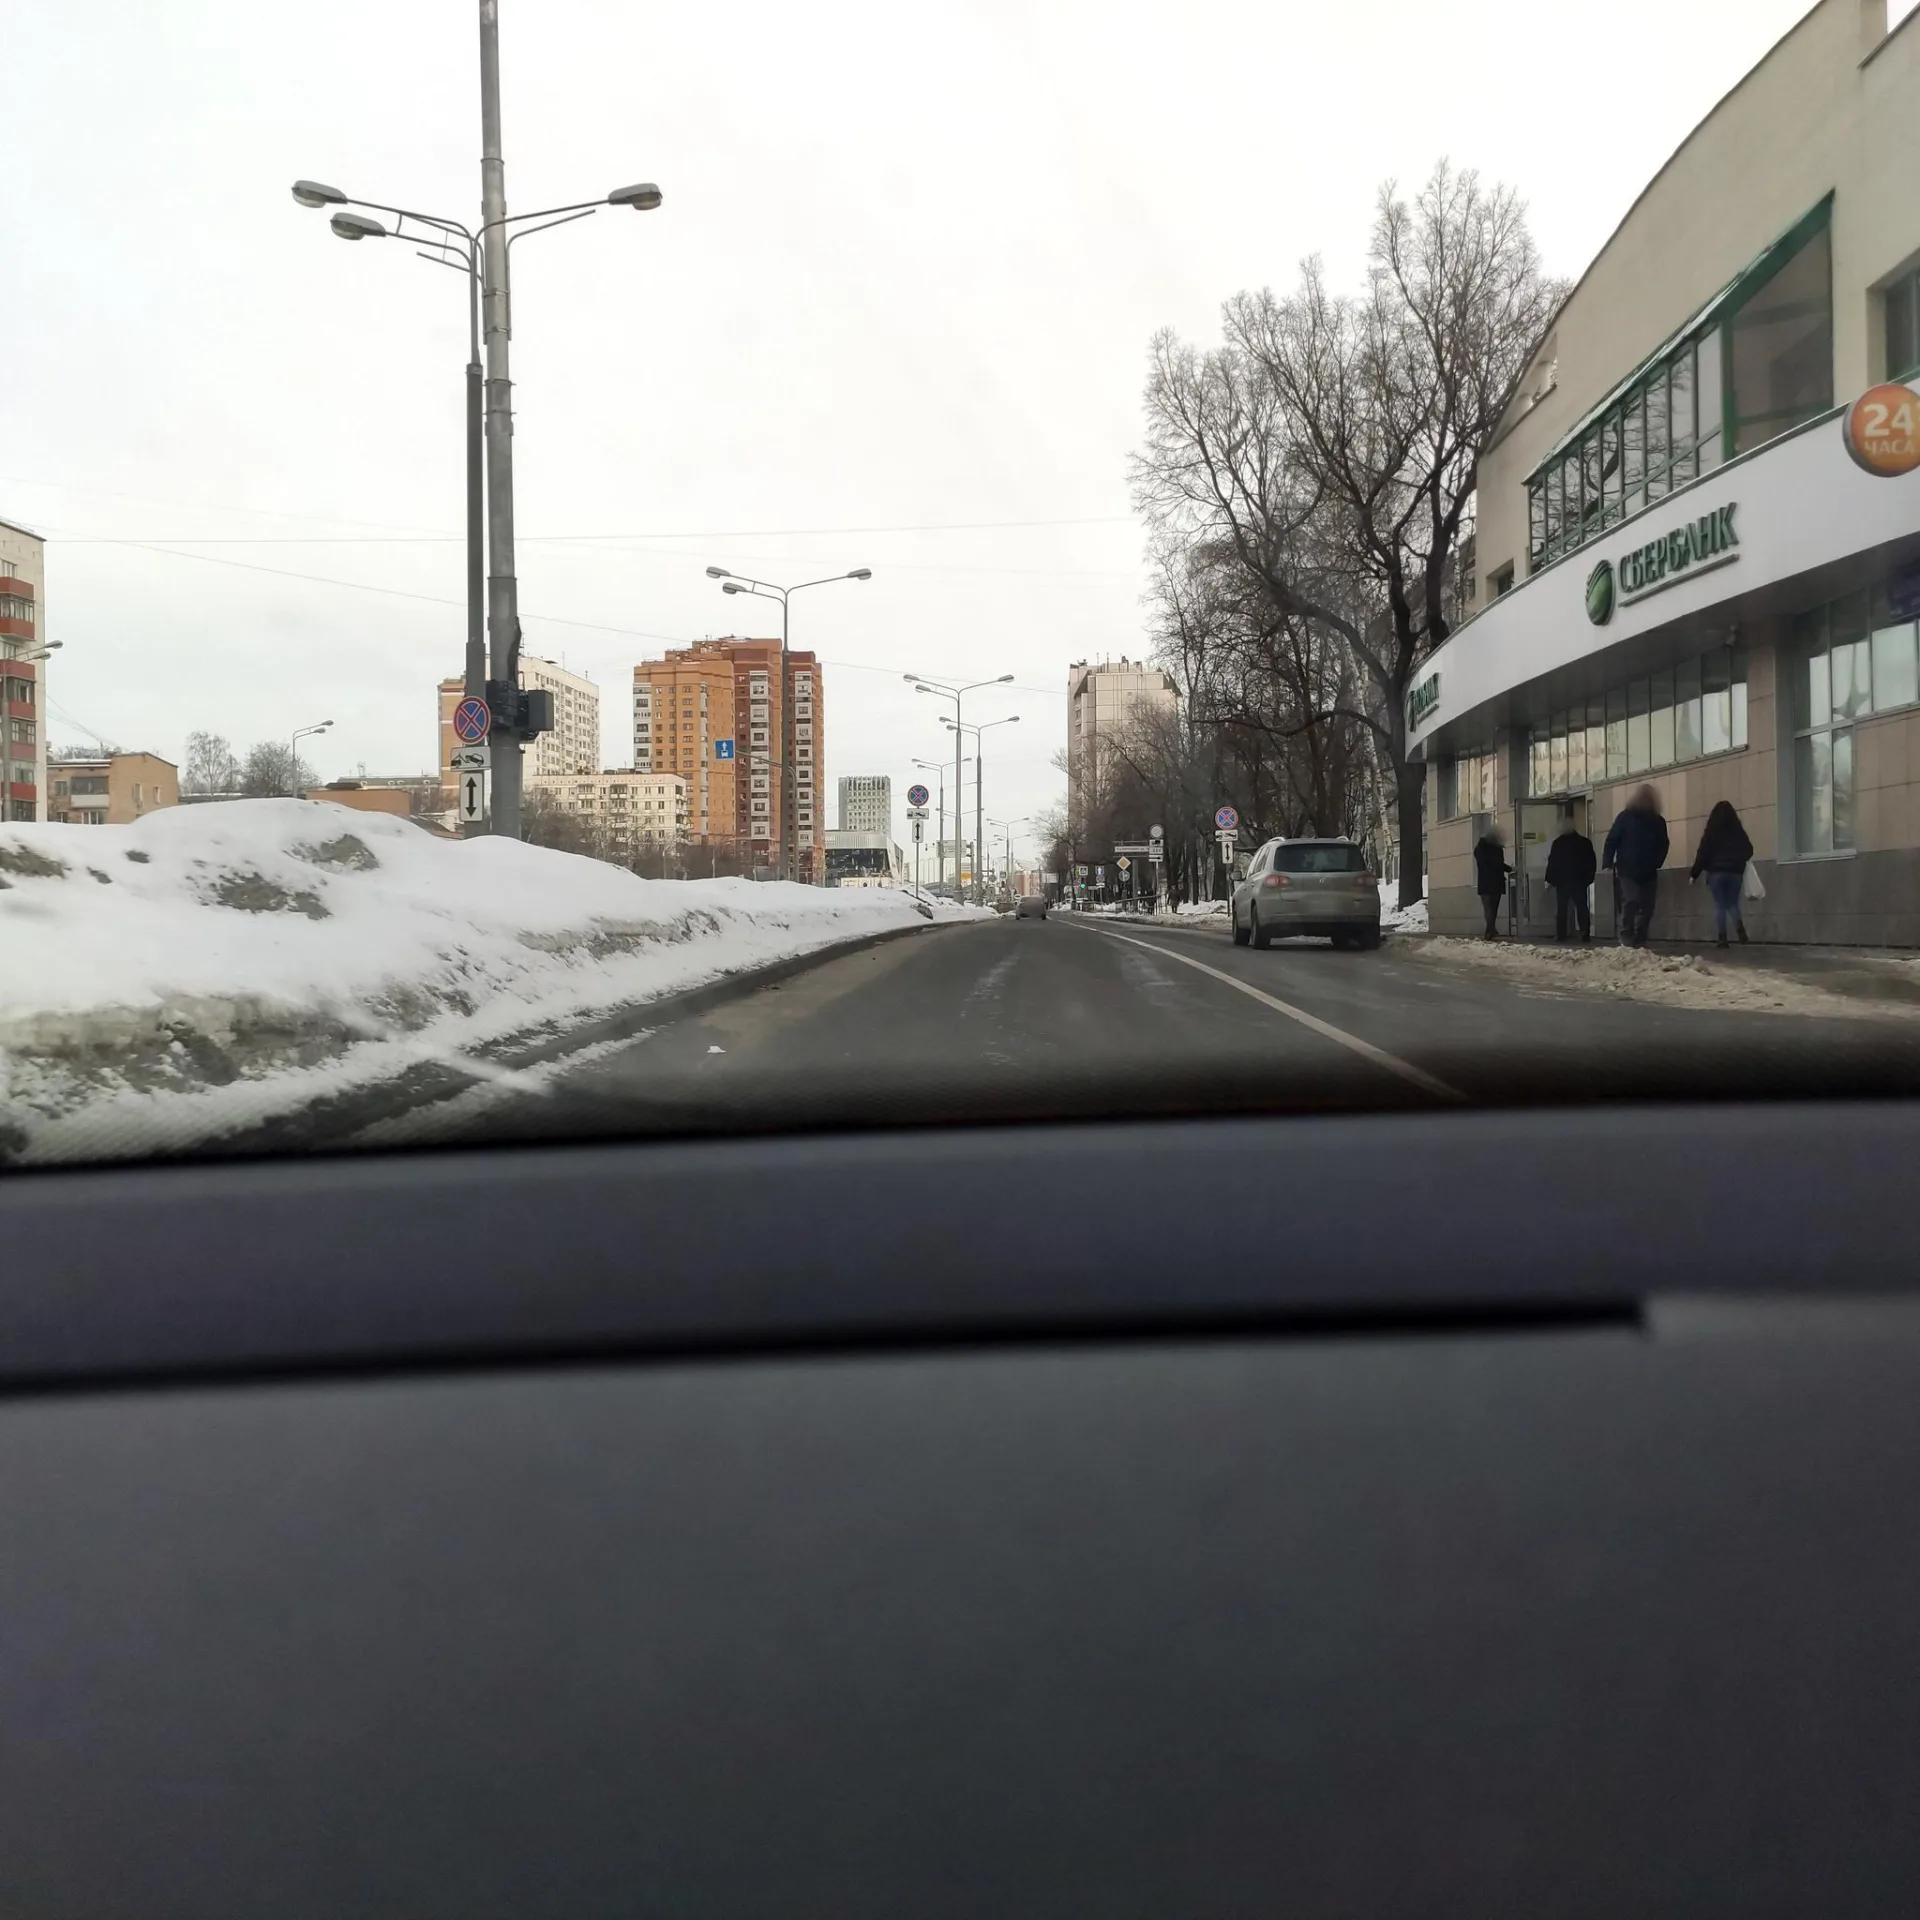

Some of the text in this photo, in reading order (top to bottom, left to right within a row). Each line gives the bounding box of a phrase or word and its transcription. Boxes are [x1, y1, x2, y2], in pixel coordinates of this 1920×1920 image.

[1862, 403, 1914, 437] 24
[1864, 439, 1915, 455] ЧАСА
[1618, 501, 1740, 593] СБЕРБАНК
